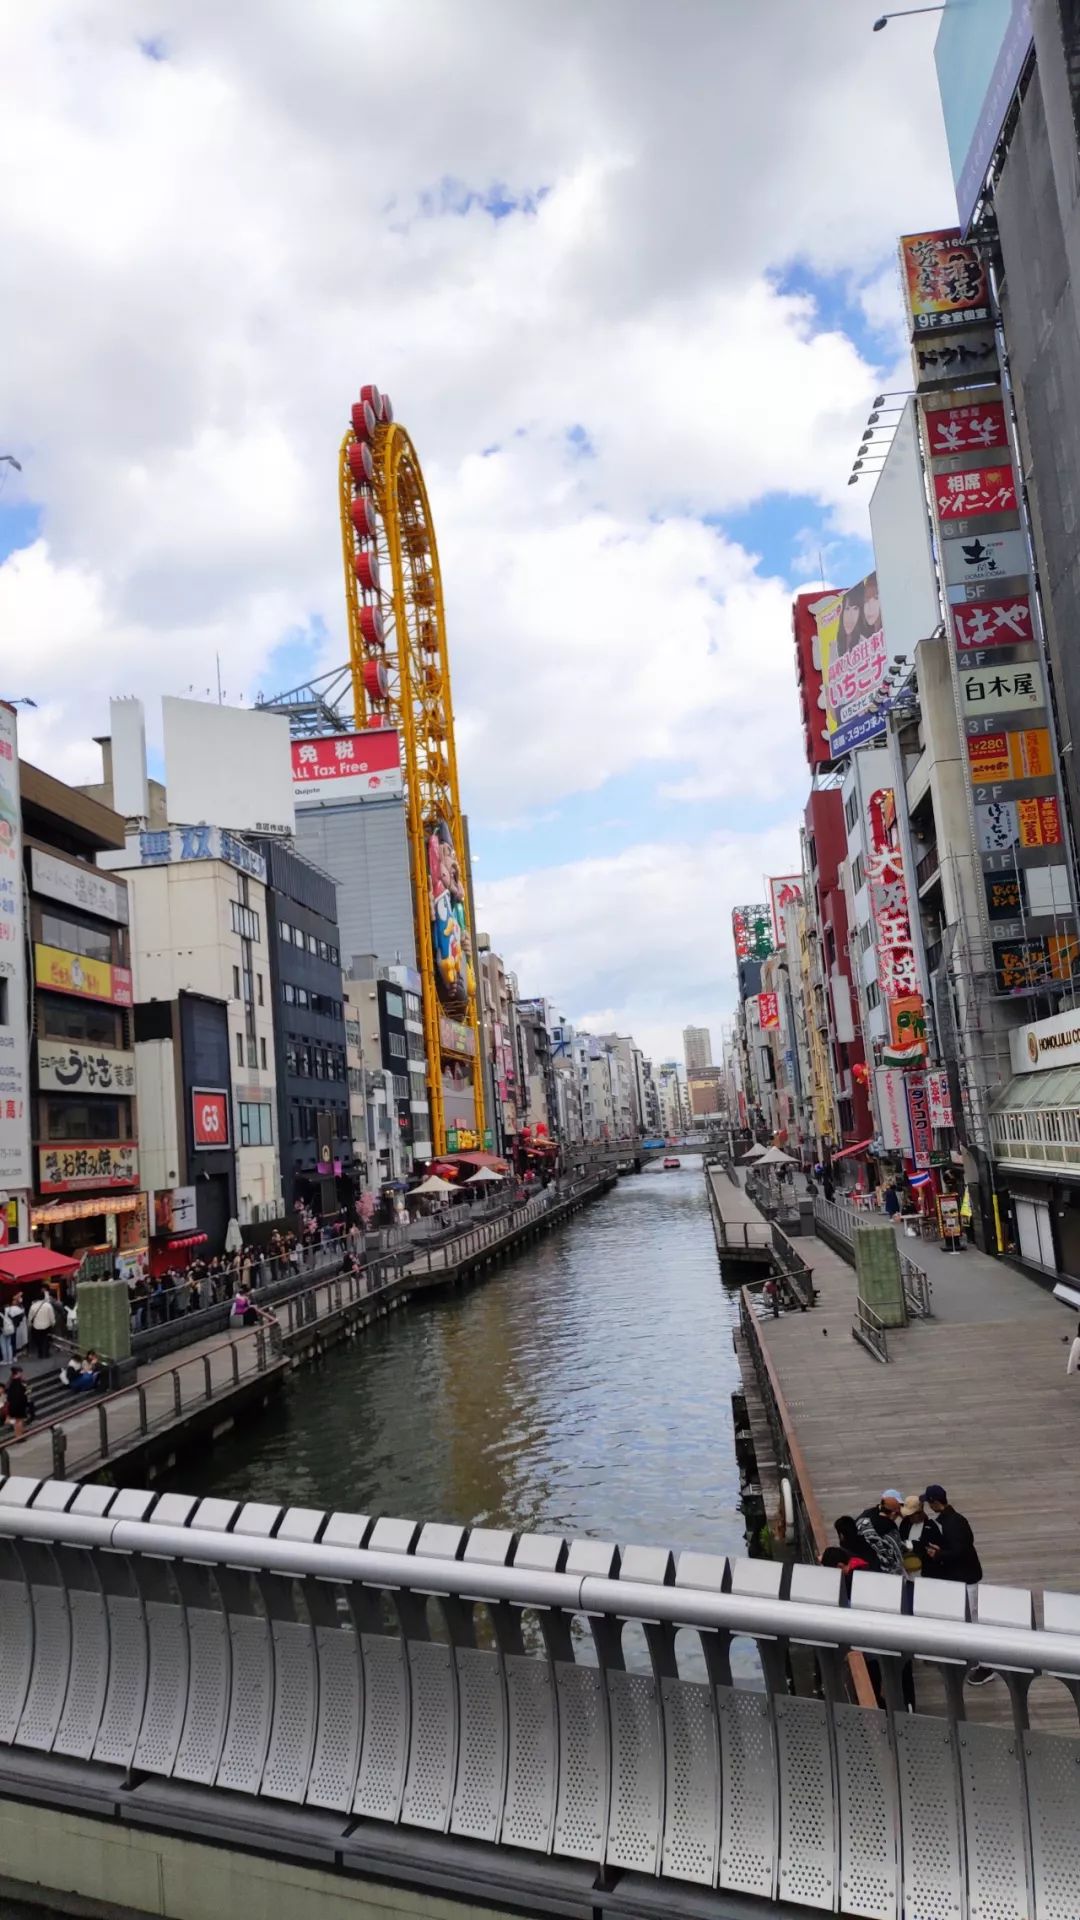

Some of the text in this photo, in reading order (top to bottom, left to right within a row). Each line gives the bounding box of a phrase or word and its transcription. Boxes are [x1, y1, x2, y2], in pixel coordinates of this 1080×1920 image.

[918, 313, 937, 328] 9F
[947, 473, 981, 493] 相席
[938, 487, 1015, 515] ダイニング
[966, 585, 986, 599] 5F
[954, 604, 1030, 646] はや
[960, 651, 986, 667] 4F
[965, 673, 1037, 702] 白木屋
[968, 718, 994, 733] 3F
[298, 740, 355, 764] 免税
[313, 765, 337, 777] Tax
[340, 761, 368, 774] Free
[976, 785, 1002, 801] 2F
[986, 854, 1011, 869] 1F
[1038, 1030, 1072, 1052] HONOLULU
[55, 1048, 113, 1088] うなぎ
